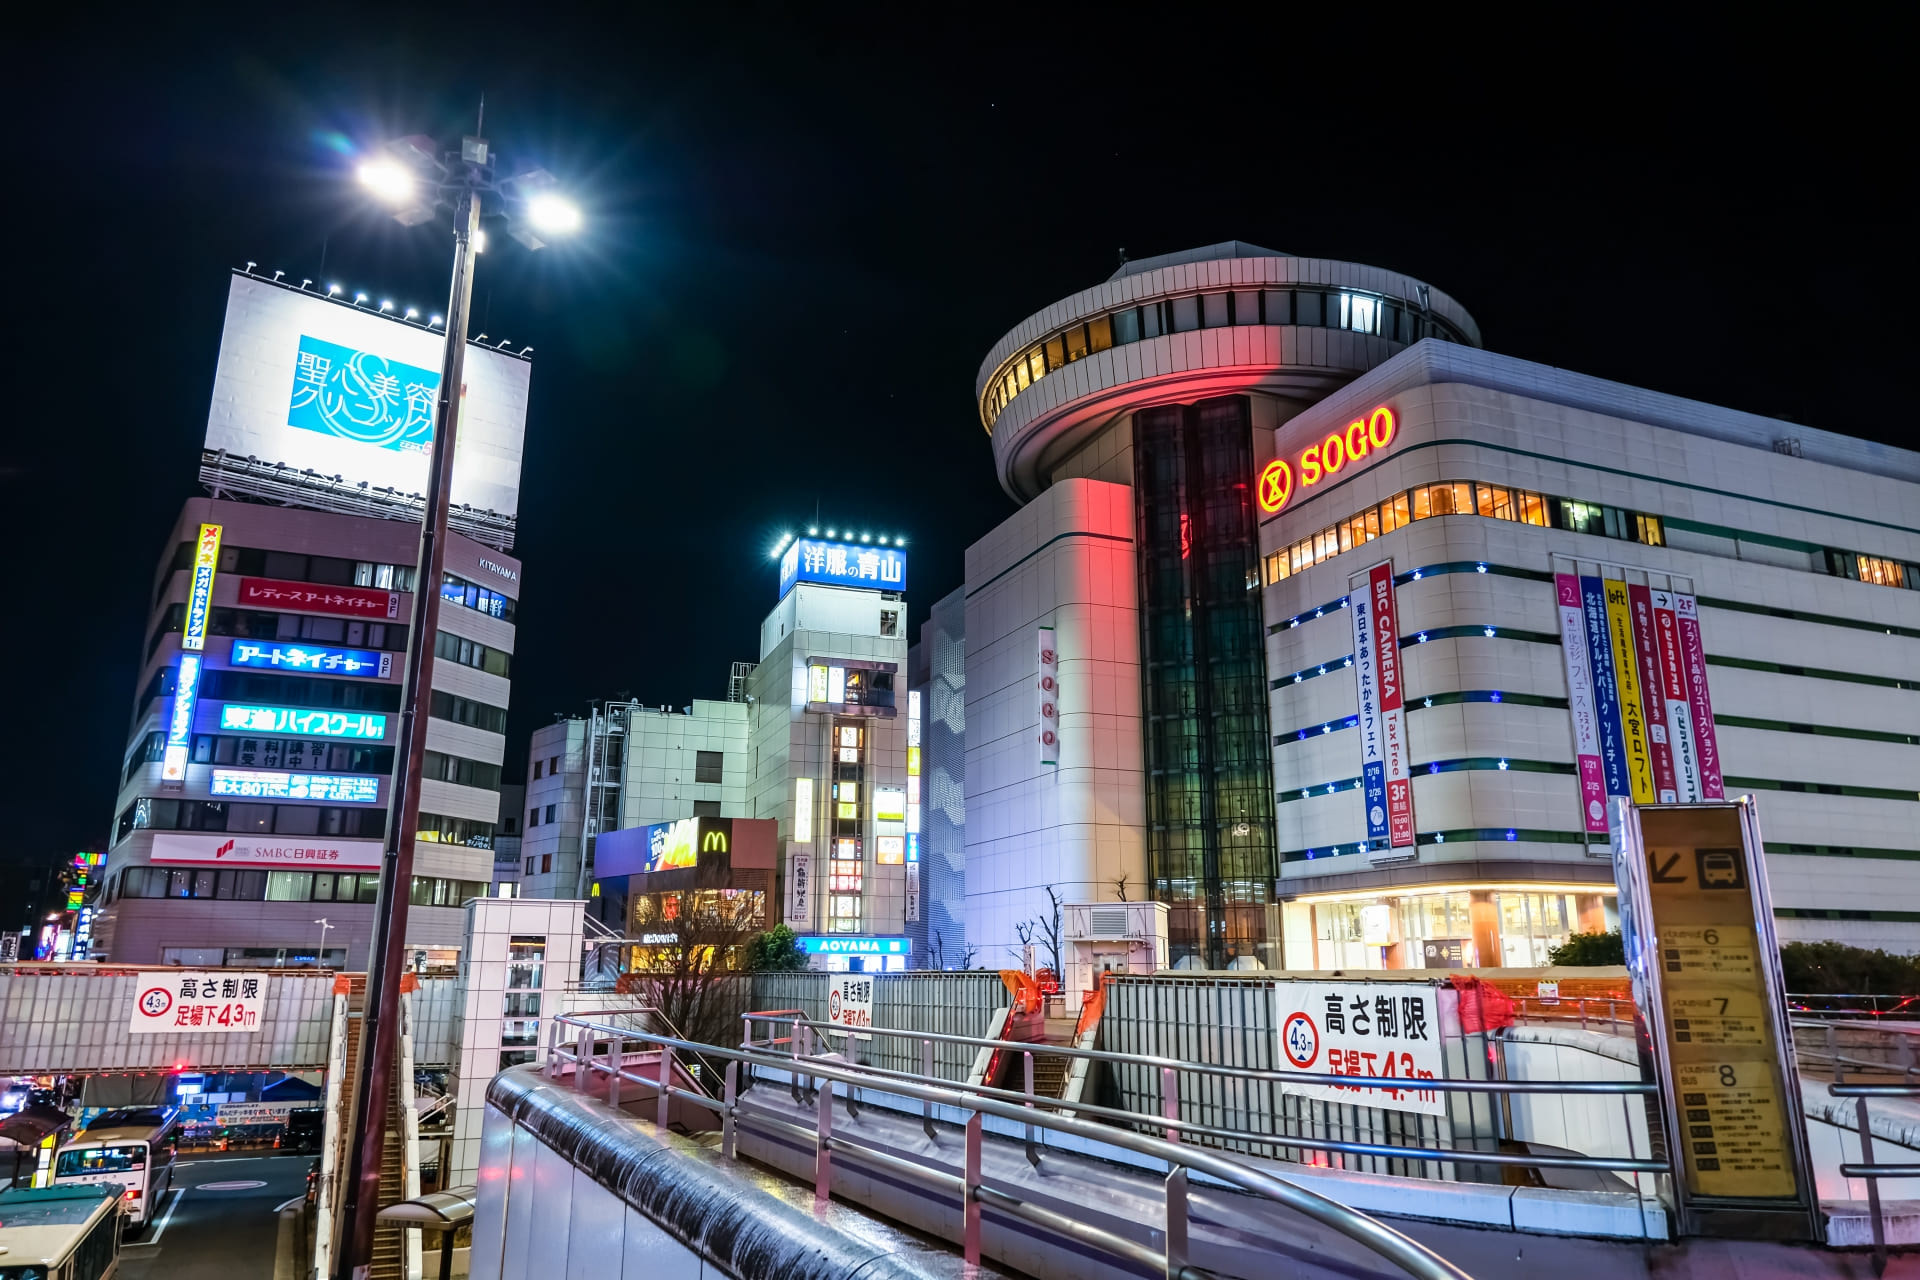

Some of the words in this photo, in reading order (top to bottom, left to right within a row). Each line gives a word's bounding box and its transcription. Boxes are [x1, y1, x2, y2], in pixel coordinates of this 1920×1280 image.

[296, 350, 434, 414] 聖心美容
[291, 385, 431, 438] クリニック
[1300, 407, 1394, 488] SOGO
[199, 527, 218, 565] メガネ
[479, 557, 517, 582] KITAYAMA
[803, 545, 902, 583] 洋服の青山
[189, 568, 211, 637] メガネドラッグ
[249, 586, 302, 602] レディース
[304, 592, 385, 609] アートネイチャー
[388, 597, 398, 615] 9F
[1375, 579, 1389, 612] BIC
[1678, 598, 1693, 611] 2F
[237, 645, 375, 671] アートネイチャー
[381, 656, 390, 674] 8F
[1379, 615, 1396, 699] CAMERA
[1356, 602, 1377, 757] 東日本あったか冬フェス
[1042, 648, 1056, 747] SOGO
[223, 706, 377, 738] 東進ハイスクール
[1388, 712, 1398, 740] Tax
[1390, 742, 1400, 776] Free
[1626, 699, 1649, 795] 大宮ロフト
[1390, 784, 1406, 801] 3F
[255, 847, 340, 861] SMBC日興証券
[819, 940, 881, 952] AOYAMA
[1703, 928, 1720, 946] 6
[179, 978, 259, 999] 高さ制限
[843, 980, 870, 1003] 高さ制限
[174, 1003, 256, 1027] 足場下4.3m
[1324, 993, 1428, 1041] 高さ制限
[1712, 997, 1729, 1016] 7
[1290, 1026, 1313, 1052] 4.3m
[1718, 1064, 1737, 1087] 8
